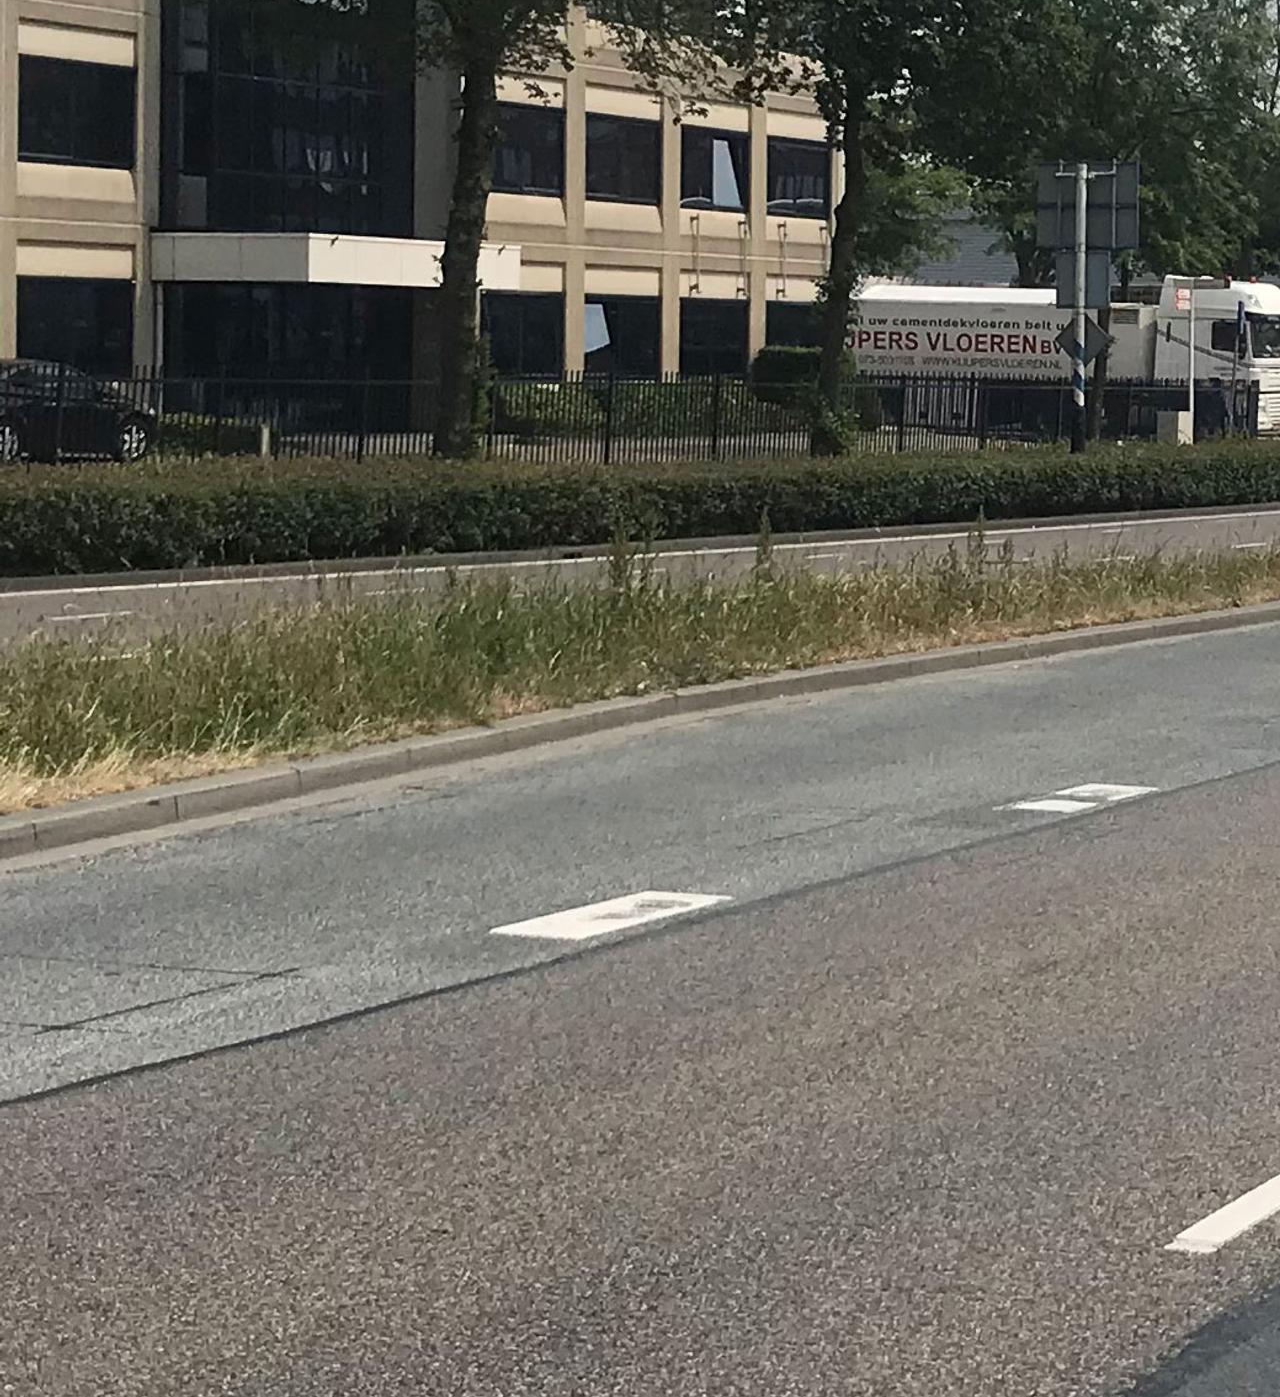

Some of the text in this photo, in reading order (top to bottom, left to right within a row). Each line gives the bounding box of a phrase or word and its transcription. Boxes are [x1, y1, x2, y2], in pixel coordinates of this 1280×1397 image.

[892, 317, 1020, 330] cementdekvloeren
[1025, 320, 1051, 330] belt
[926, 331, 1037, 353] VLOEREN
[1041, 340, 1061, 354] BV
